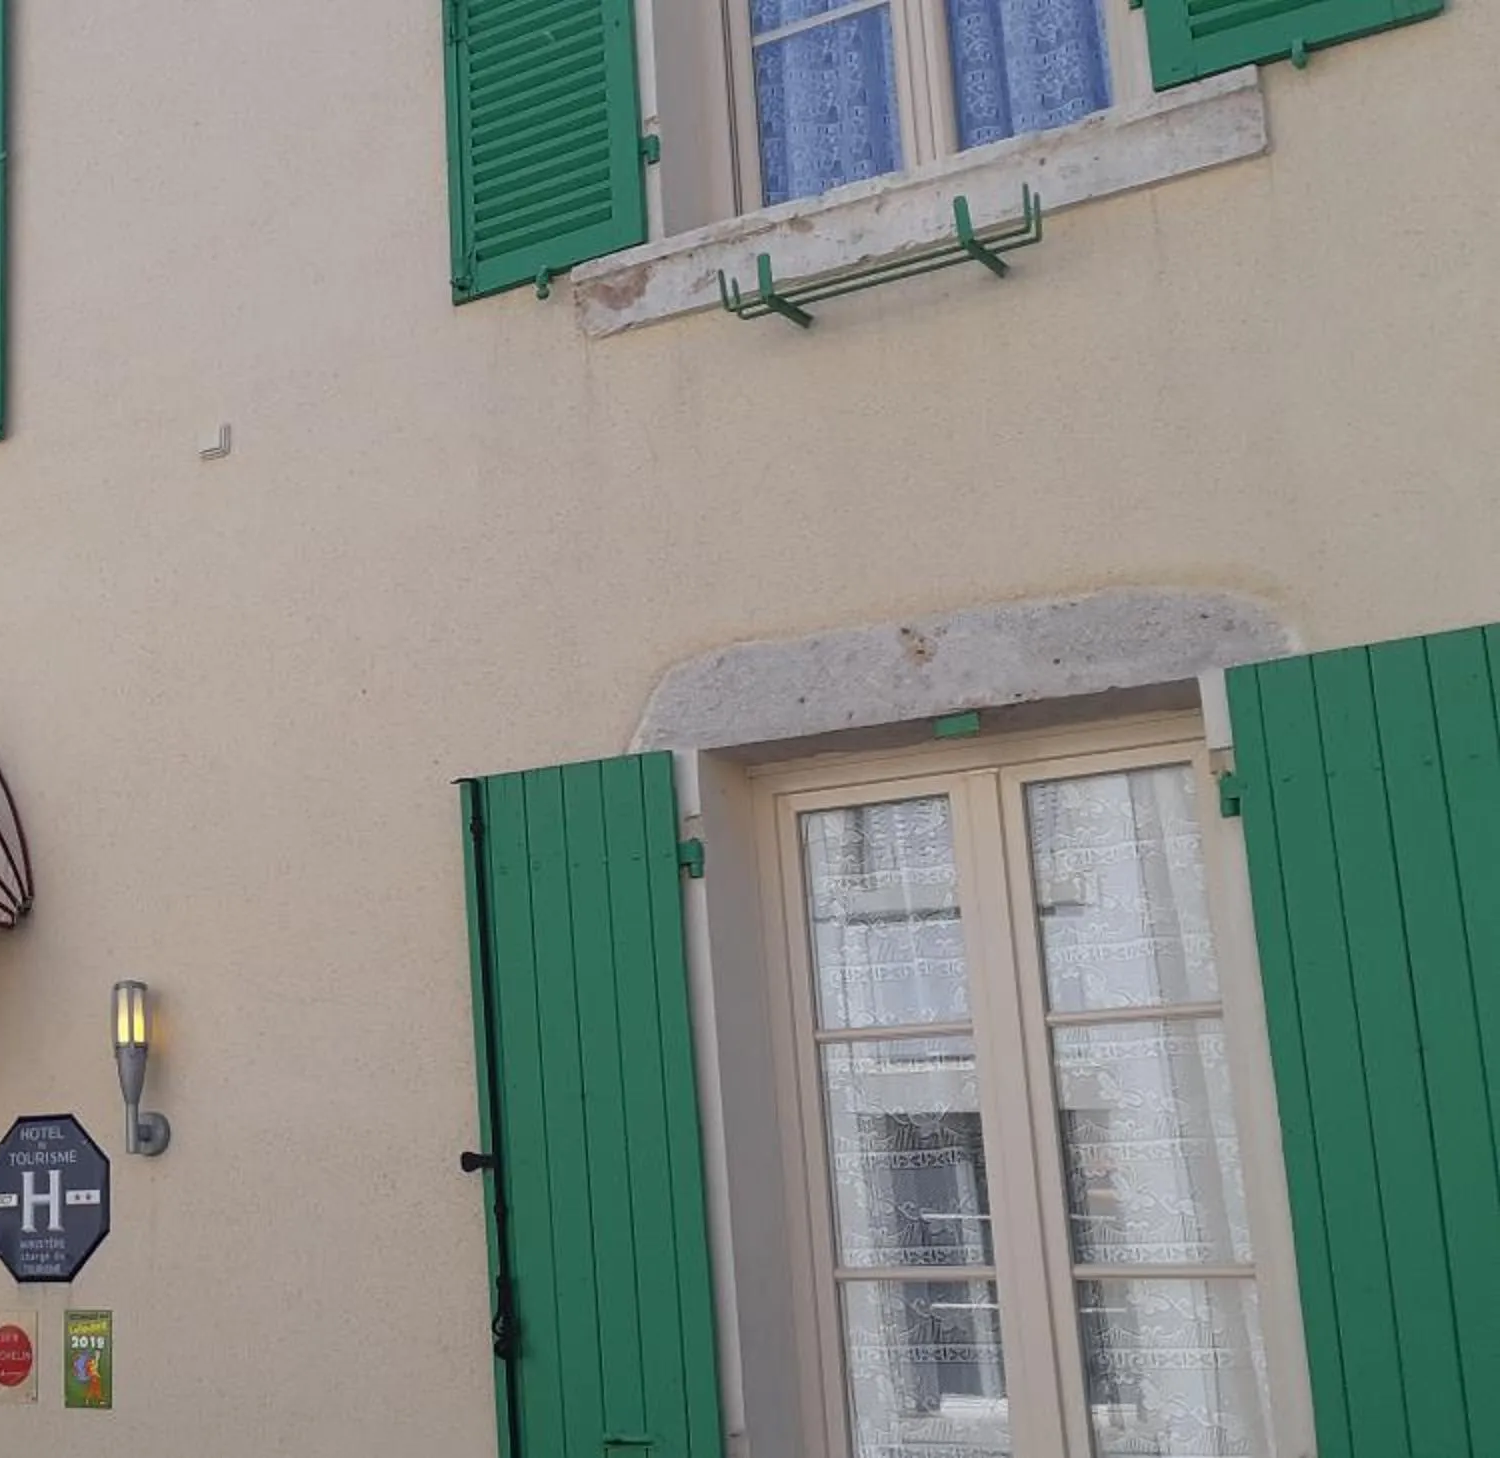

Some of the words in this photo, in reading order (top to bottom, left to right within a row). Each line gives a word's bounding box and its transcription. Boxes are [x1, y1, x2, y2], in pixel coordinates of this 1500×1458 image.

[20, 1126, 65, 1141] HOTEL
[8, 1150, 78, 1167] TOURISME
[20, 1169, 65, 1233] H
